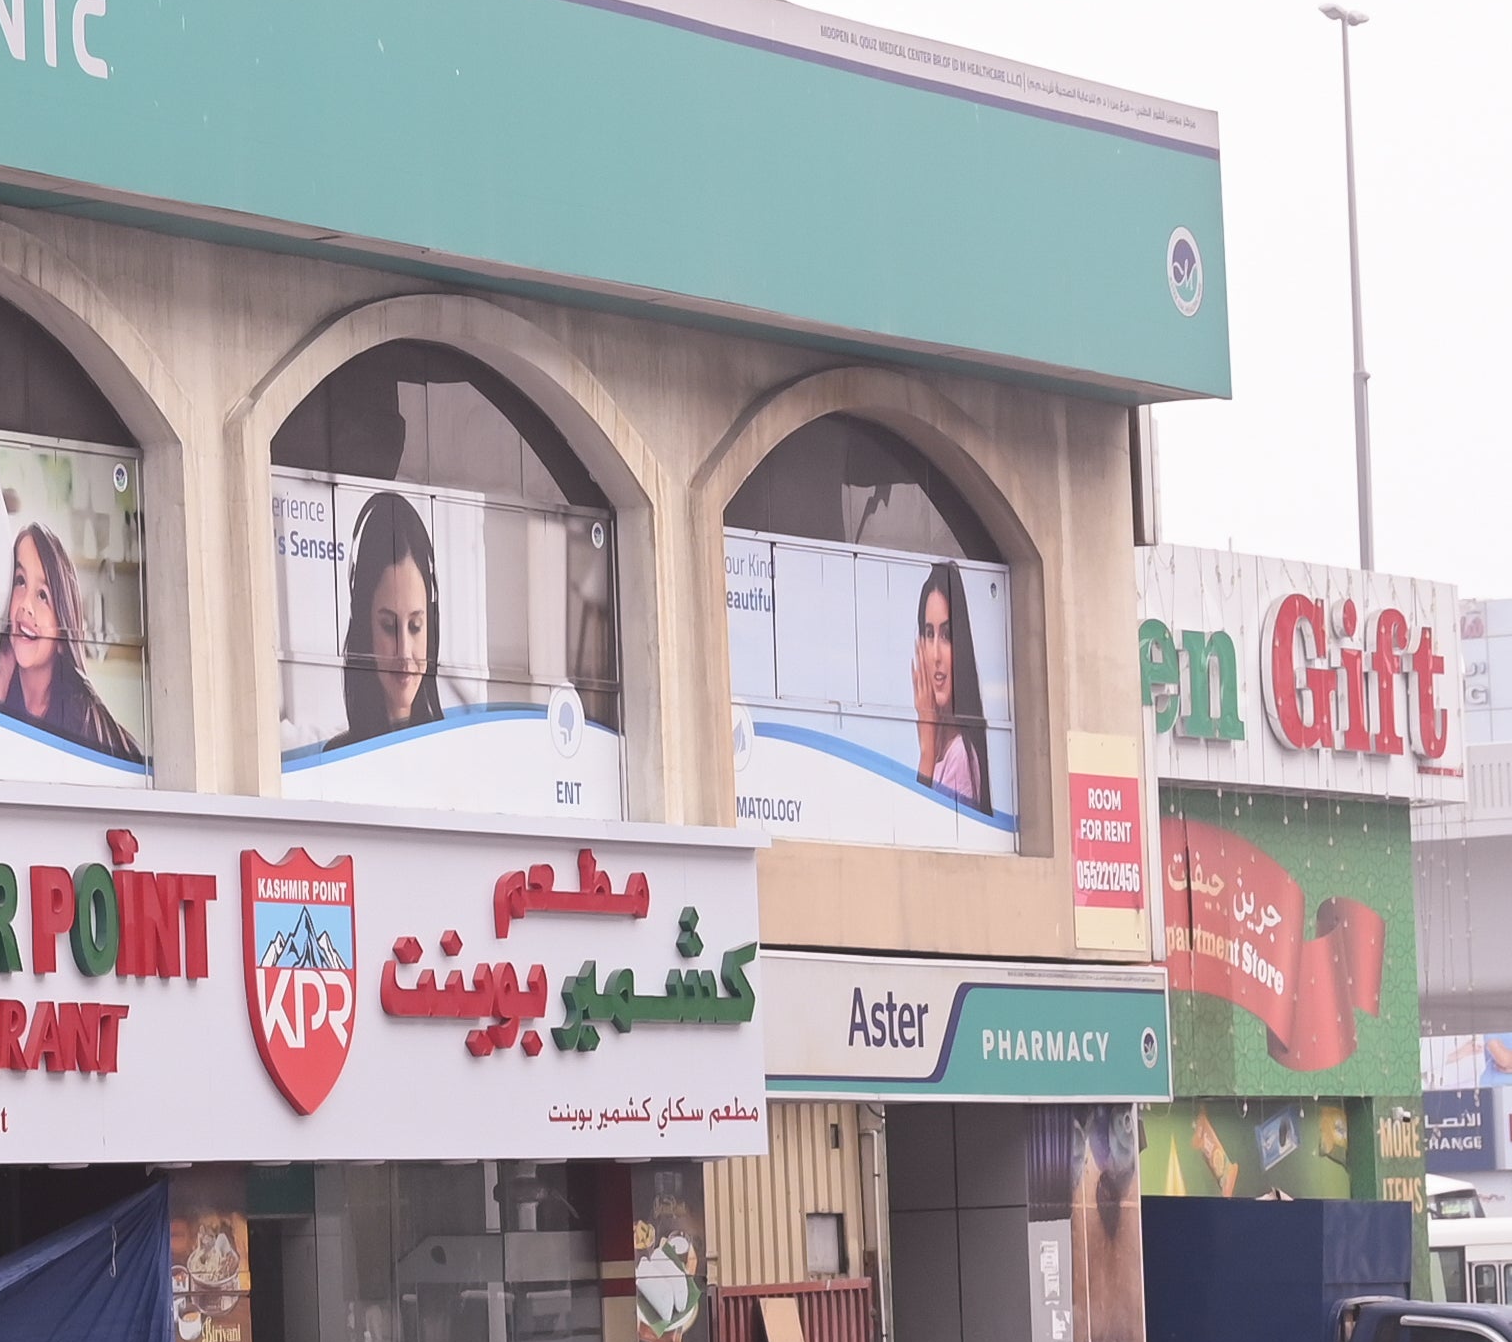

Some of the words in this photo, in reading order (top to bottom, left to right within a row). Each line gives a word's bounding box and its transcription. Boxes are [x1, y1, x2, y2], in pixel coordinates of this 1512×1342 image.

[878, 40, 907, 59] MEDICAL
[907, 47, 932, 65] CENTER
[967, 62, 1006, 83] HEALTHCARE
[272, 495, 325, 523] erience
[290, 530, 345, 562] Senses
[724, 554, 745, 577] our
[726, 588, 774, 613] eautifu
[1140, 618, 1245, 742] en
[1261, 593, 1448, 760] Gift
[555, 780, 582, 806] ENT
[736, 795, 802, 823] MATOLOGY
[1087, 787, 1122, 811] ROOM
[1079, 818, 1103, 841] FOR
[1104, 818, 1132, 844] RENT
[257, 877, 310, 901] KASHMIR
[312, 881, 347, 903] POINT
[494, 848, 650, 939] مطعم
[1076, 861, 1141, 894] 0552212456
[30, 862, 217, 979] POINT
[1166, 923, 1239, 968] partment
[1242, 940, 1285, 996] Store
[381, 929, 547, 1058] بوينت
[551, 906, 758, 1052] كشمير
[256, 968, 353, 1049] KPR
[848, 986, 929, 1049] Aster
[982, 1028, 1110, 1062] PHARMACY
[548, 1102, 594, 1131] بوينت
[596, 1096, 653, 1131] كشمير
[658, 1096, 705, 1137] سكاي
[709, 1096, 759, 1131] مطعم
[1379, 1116, 1422, 1159] MORE
